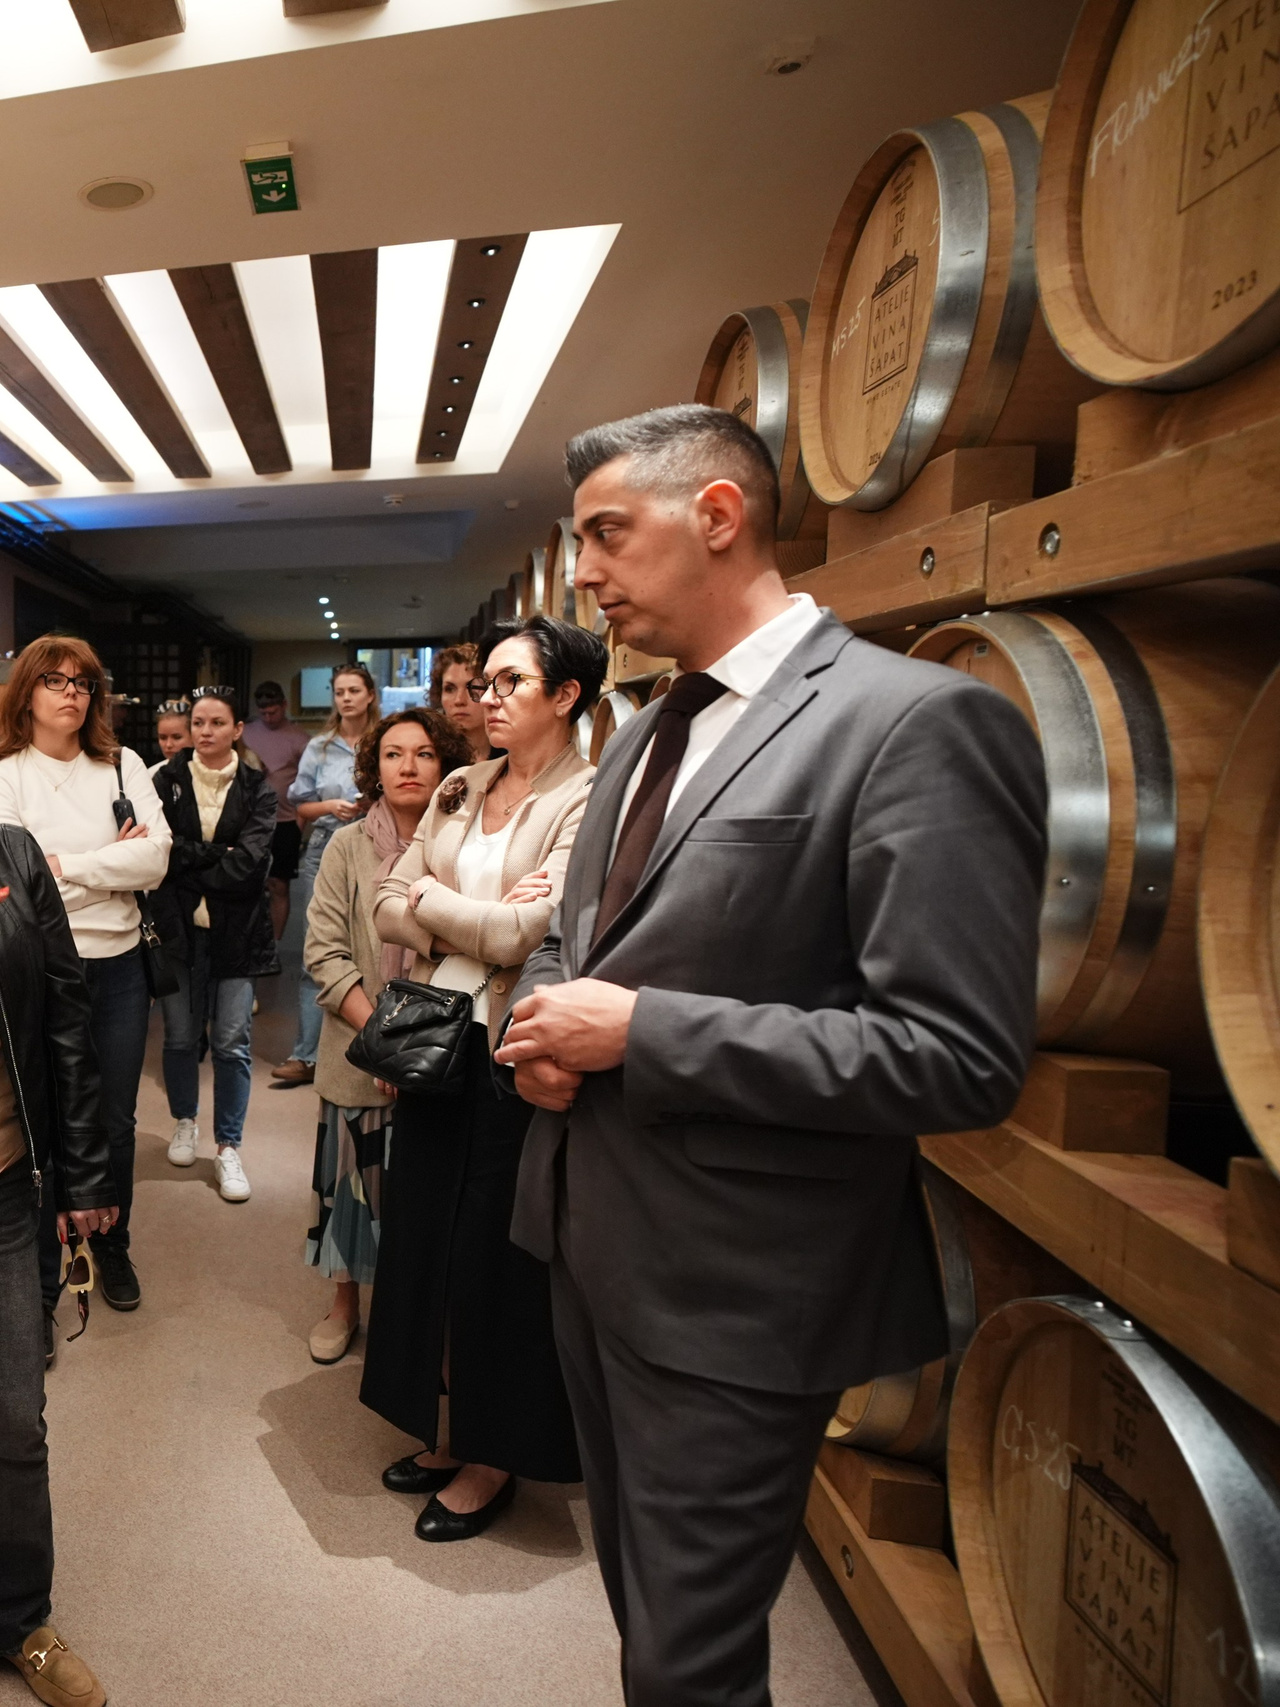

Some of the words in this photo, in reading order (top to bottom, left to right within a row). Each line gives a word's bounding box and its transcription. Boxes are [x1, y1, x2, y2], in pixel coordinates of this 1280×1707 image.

[1211, 269, 1258, 310] 2023
[873, 315, 906, 349] VINA
[1079, 1537, 1157, 1636] VINA
